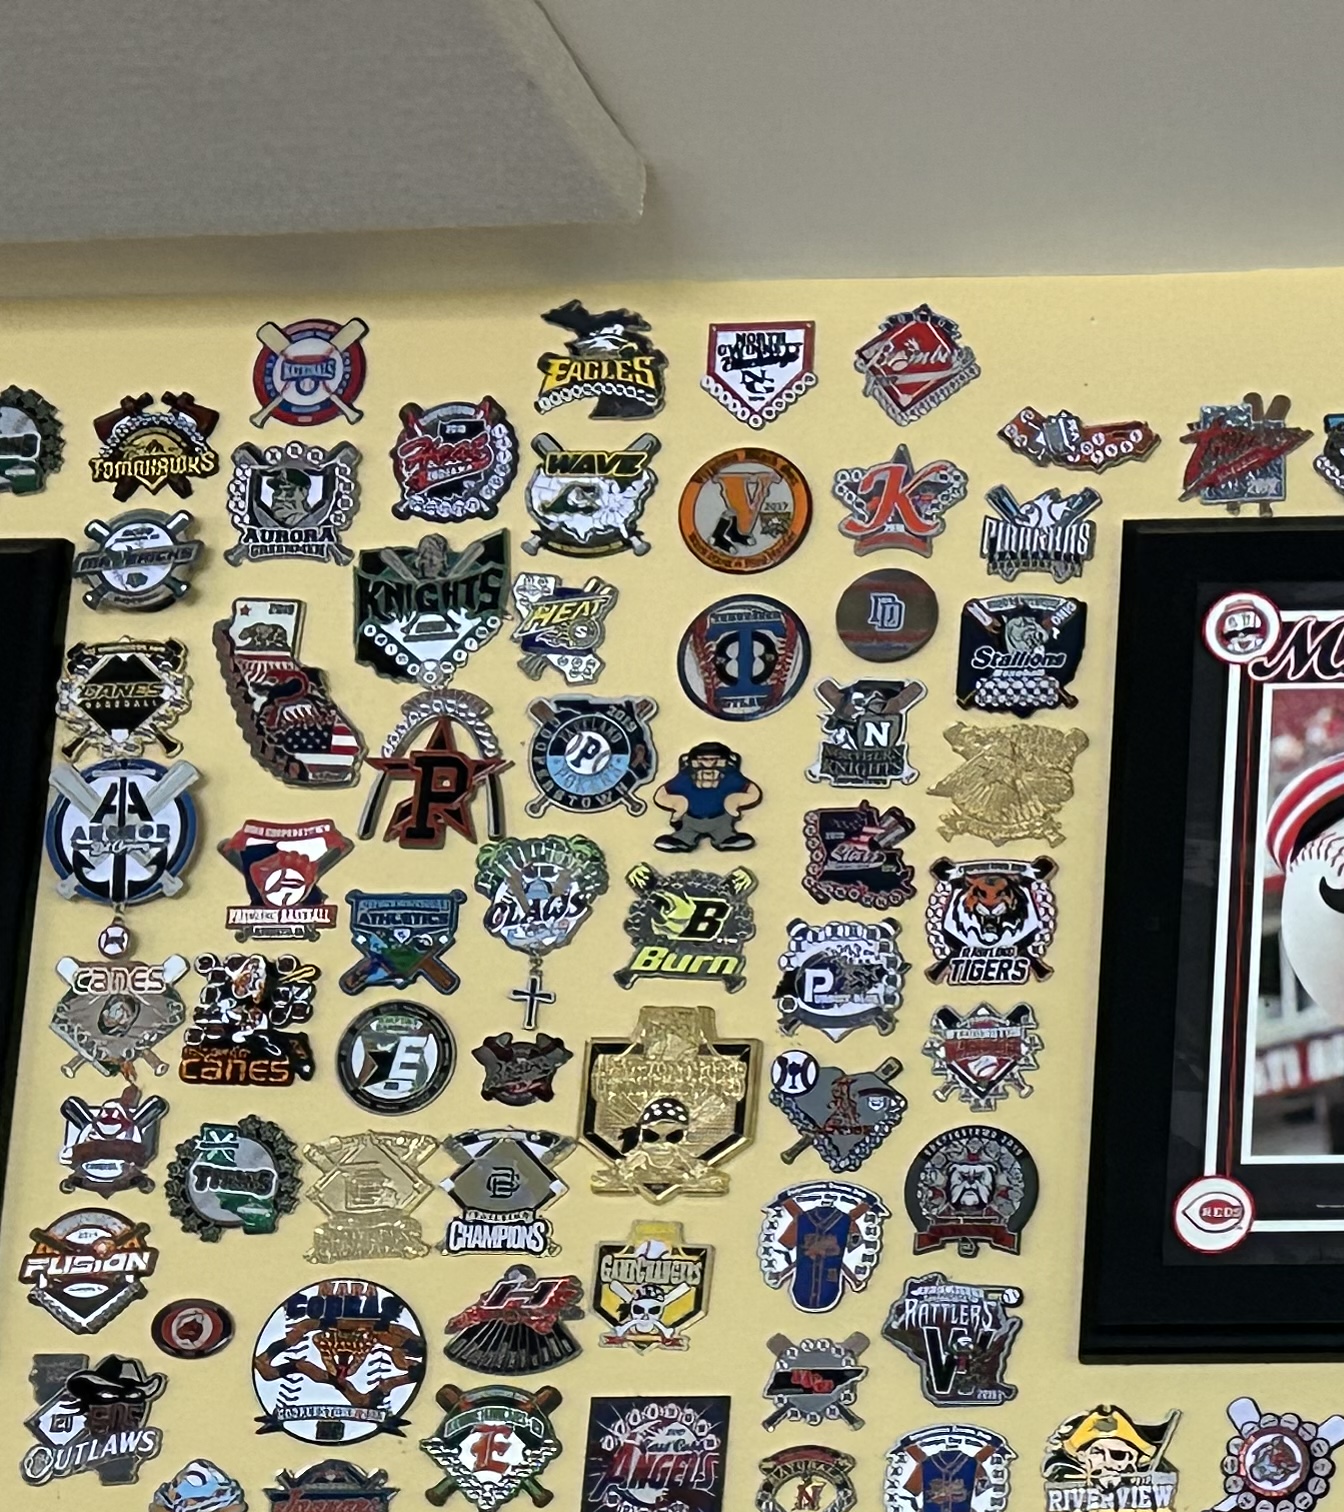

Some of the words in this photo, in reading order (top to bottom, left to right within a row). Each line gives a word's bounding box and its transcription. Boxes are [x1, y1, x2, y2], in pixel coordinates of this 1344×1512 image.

[544, 355, 656, 390] EAGLES
[546, 452, 647, 475] WAVE
[243, 526, 335, 544] AURORA
[357, 570, 502, 619] KNIGHTS
[521, 598, 603, 634] HEAT
[971, 648, 1066, 669] Stallions
[864, 722, 891, 747] N
[632, 946, 740, 977] Burn
[950, 959, 1030, 983] TIGERS
[449, 1220, 545, 1253] CHAMPIONS
[25, 1251, 151, 1278] FUSION
[903, 1299, 994, 1330] RATTLERS
[25, 1430, 156, 1479] OUTLAWS
